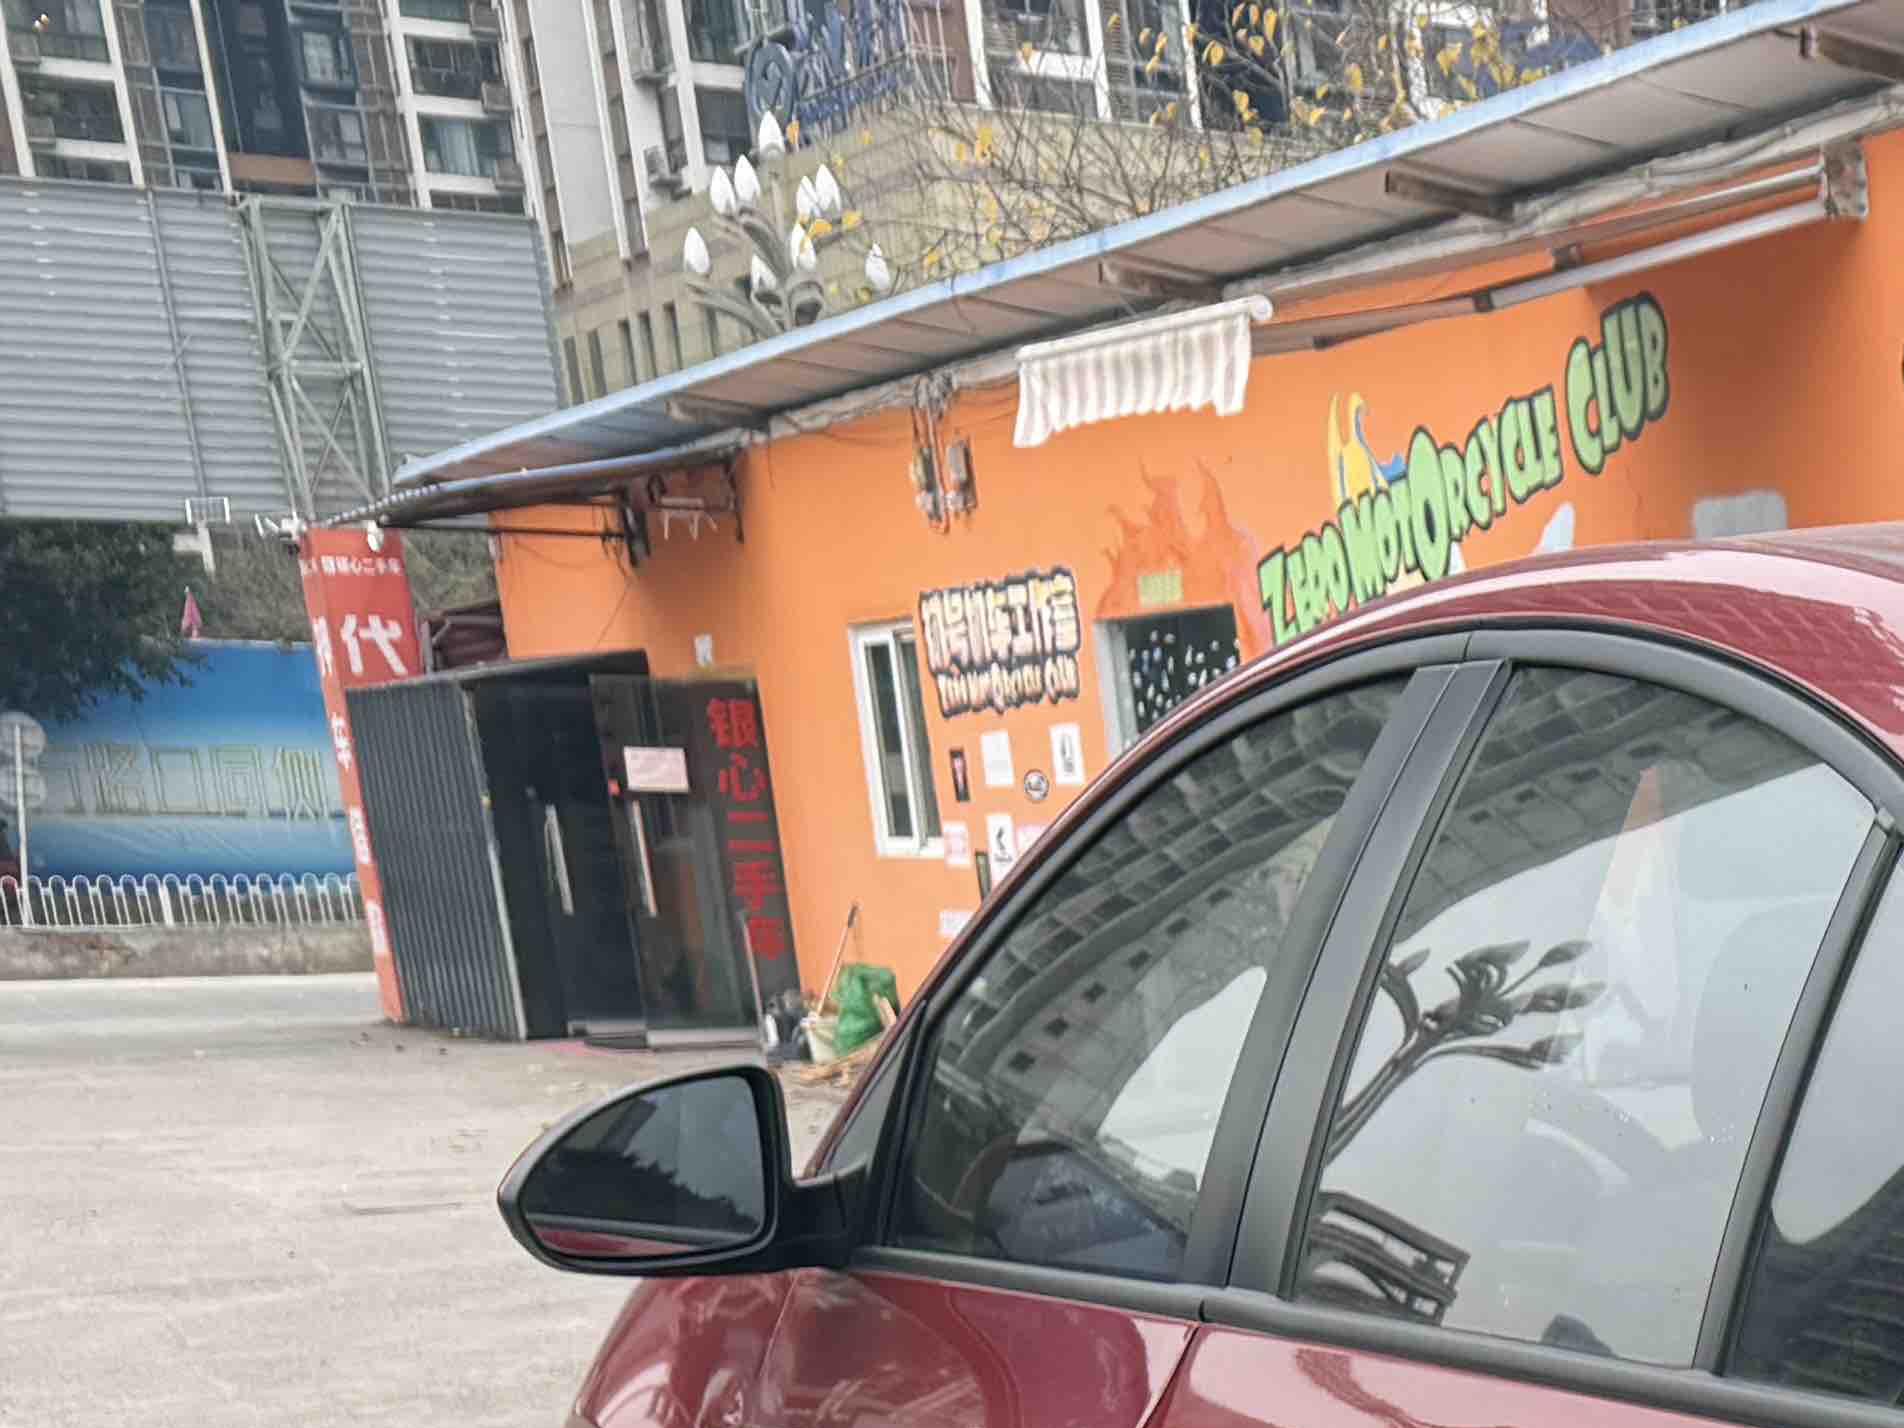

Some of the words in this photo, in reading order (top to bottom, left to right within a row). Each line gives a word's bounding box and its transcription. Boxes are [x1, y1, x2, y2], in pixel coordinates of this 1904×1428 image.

[1340, 385, 1564, 603] MOTORCYCLE
[1565, 292, 1670, 475] CLUB
[706, 697, 786, 960] 银心二手车
